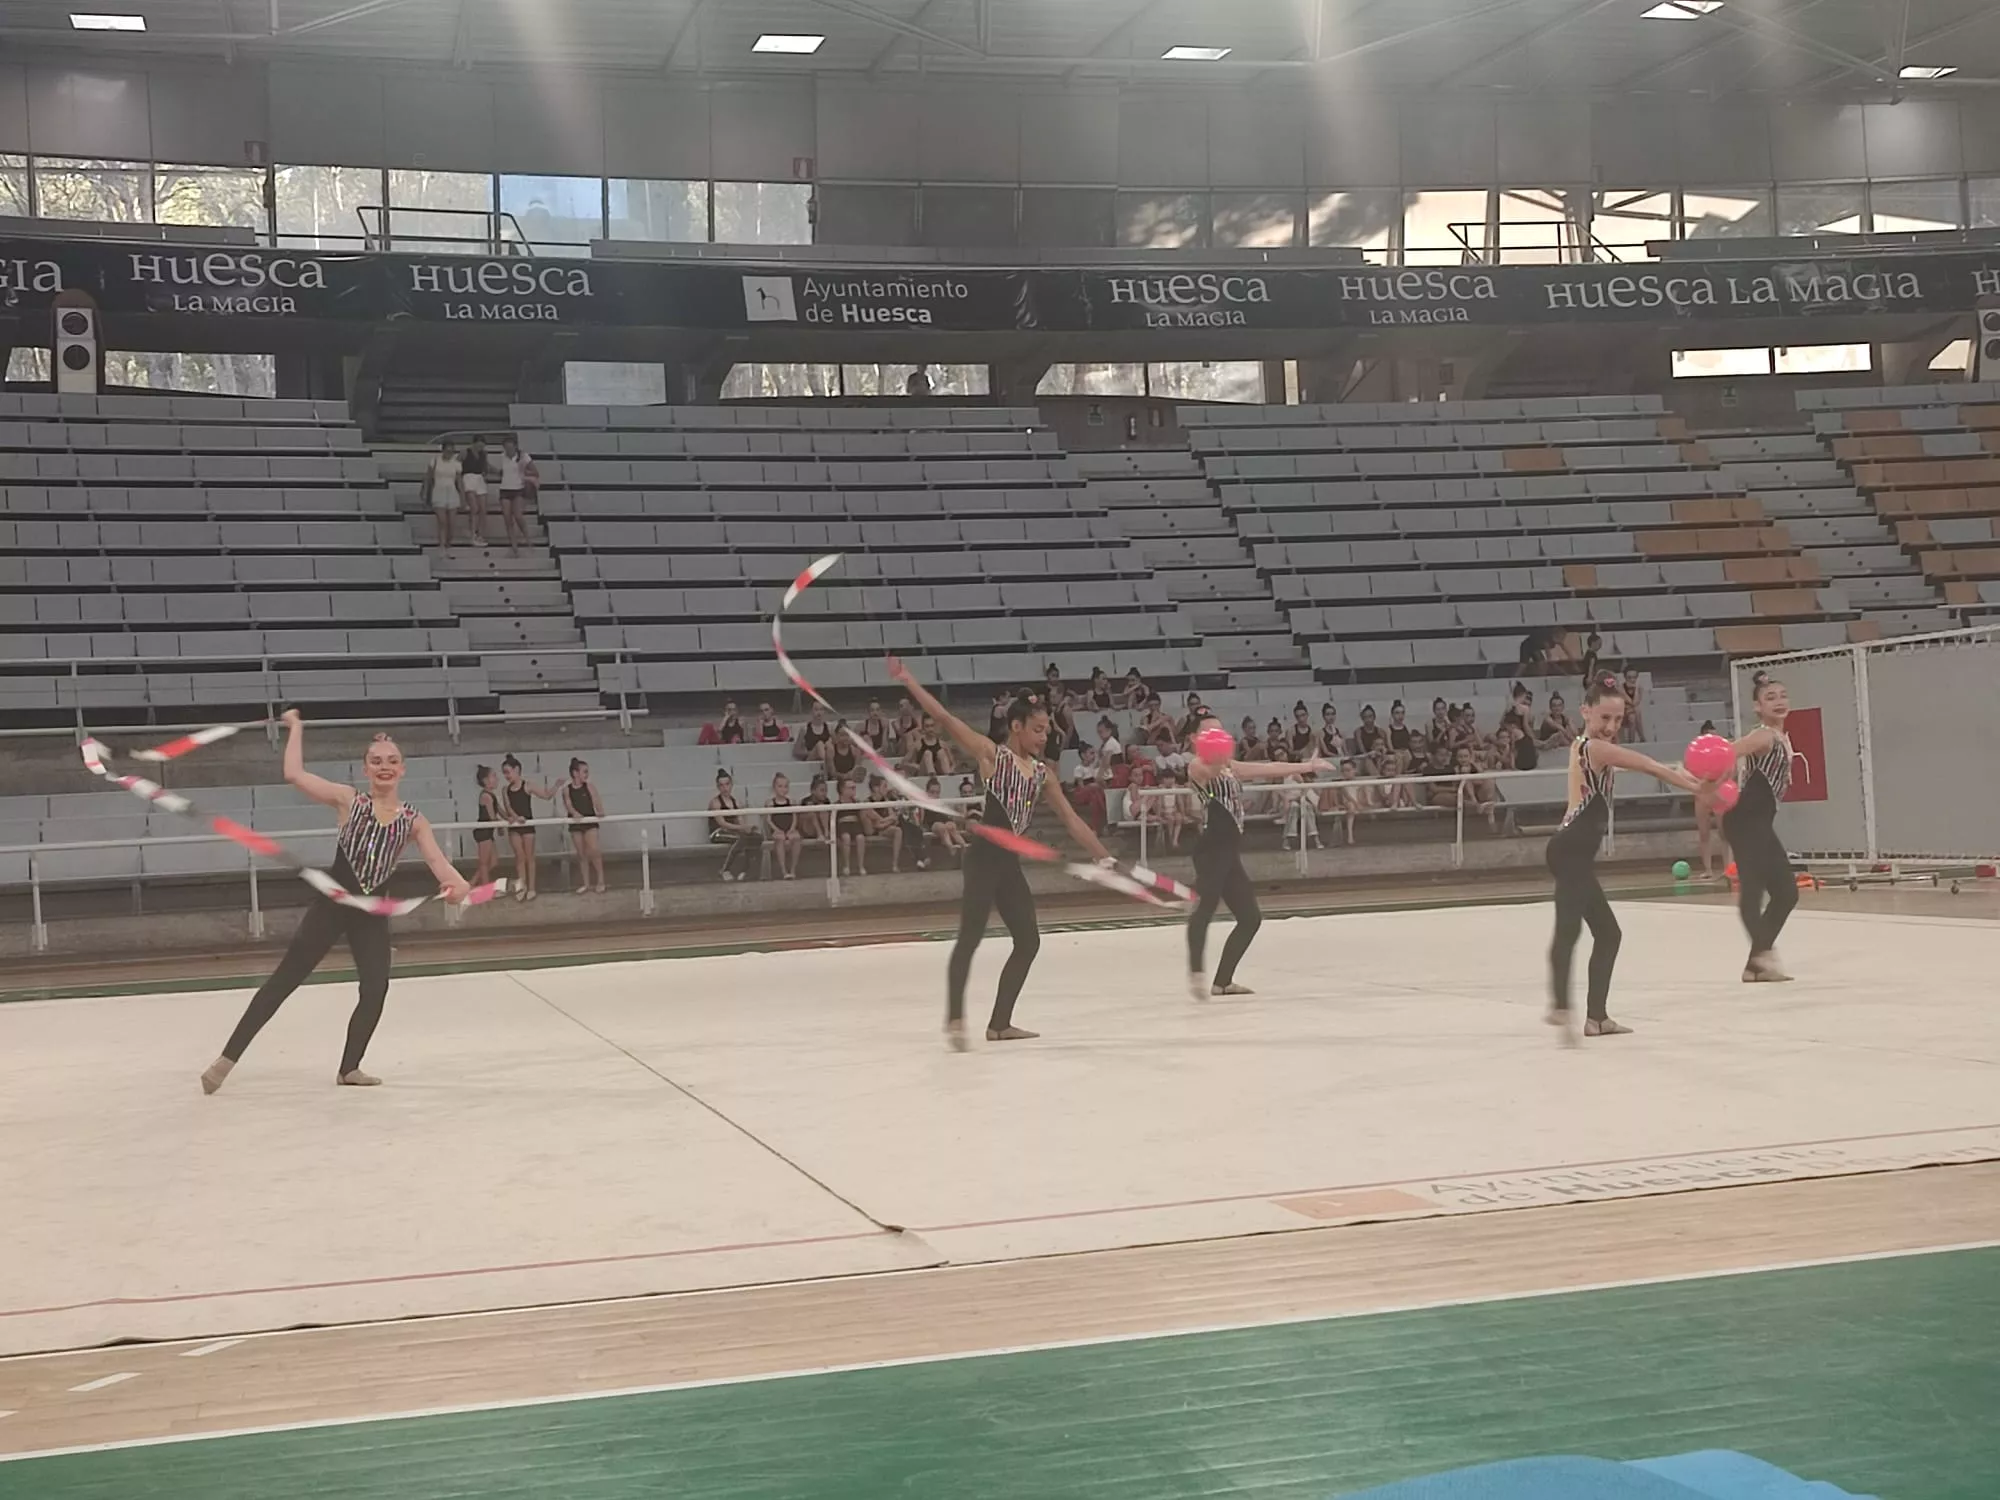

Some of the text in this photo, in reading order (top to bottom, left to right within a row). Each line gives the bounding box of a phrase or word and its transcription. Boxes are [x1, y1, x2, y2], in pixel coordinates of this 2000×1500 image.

[803, 277, 968, 302] Ayuntamiento
[805, 303, 932, 324] de Huesca
[1431, 1149, 1845, 1194] Ayuntamiento
[1459, 1192, 1536, 1205] de
[1544, 1168, 1792, 1196] Huesca
